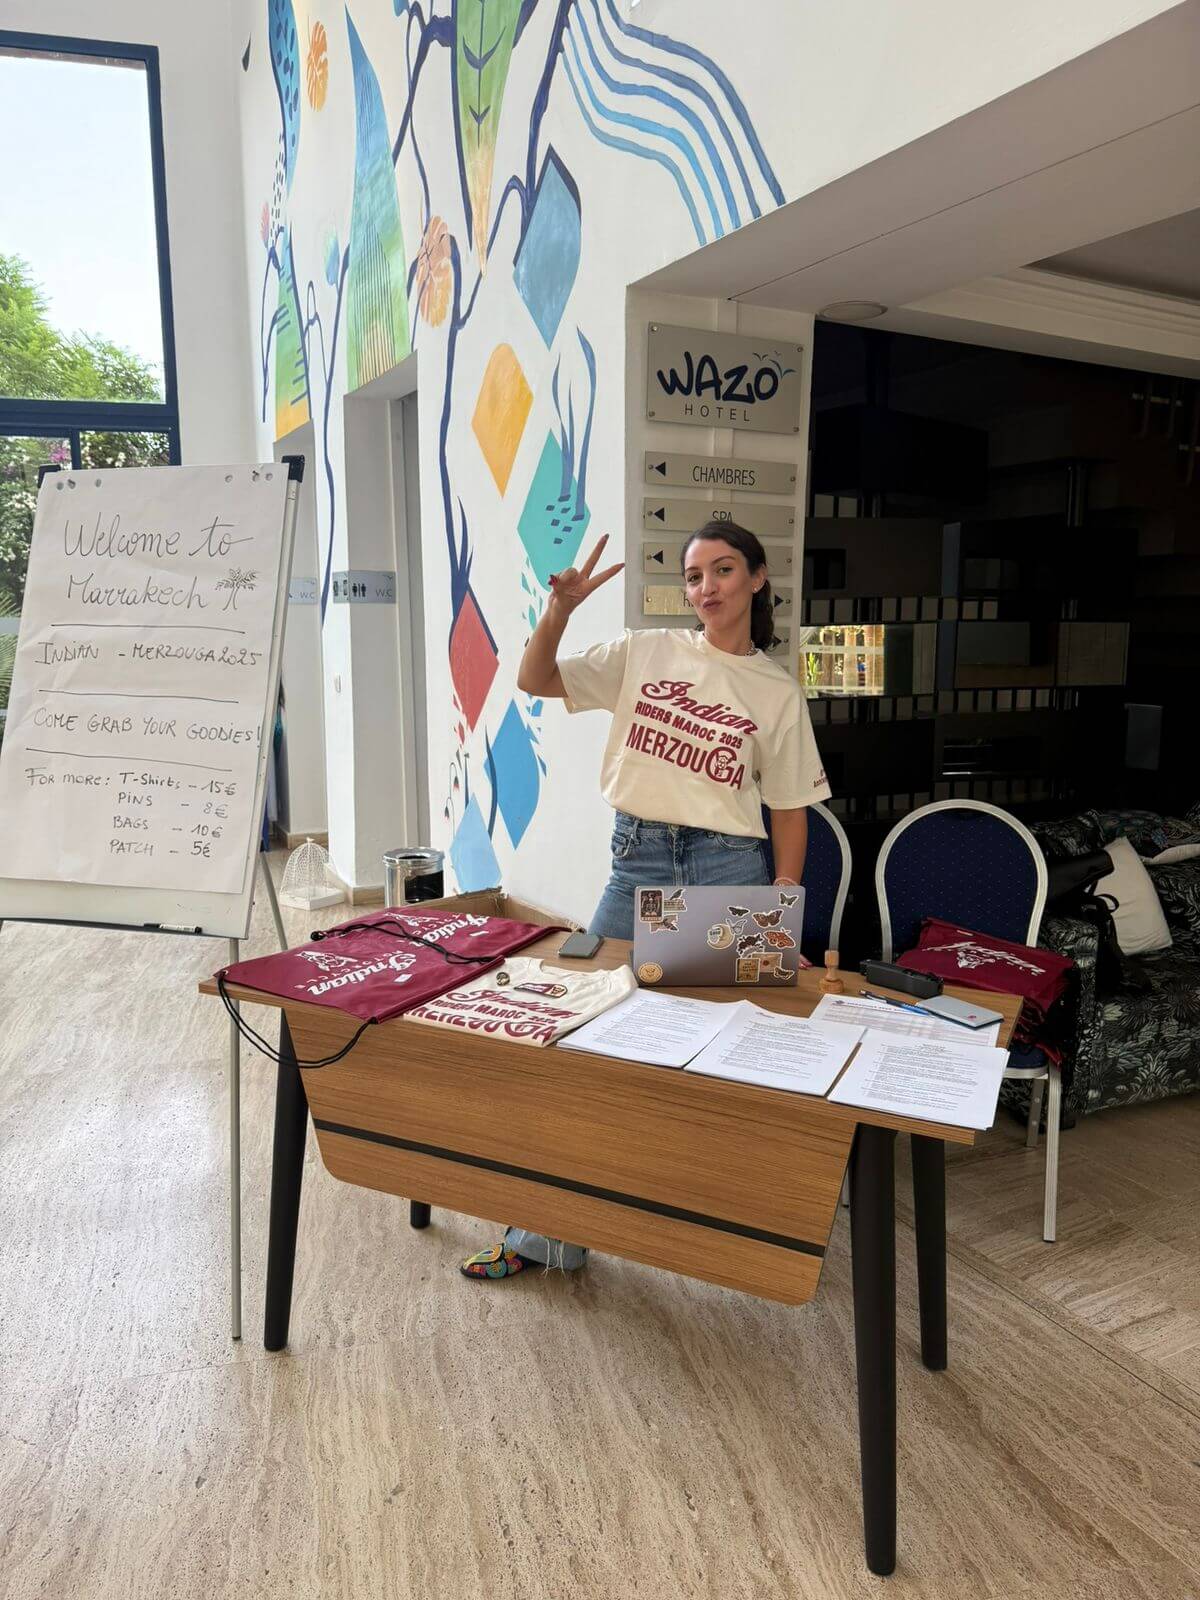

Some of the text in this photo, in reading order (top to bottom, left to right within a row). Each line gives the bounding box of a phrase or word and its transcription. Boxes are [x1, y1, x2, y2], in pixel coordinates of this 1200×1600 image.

[656, 351, 780, 404] WAZO
[684, 404, 750, 422] HOTEL
[692, 465, 756, 486] CHAMBRES
[64, 512, 254, 558] Welcome to
[67, 572, 208, 610] Marrakech
[33, 707, 78, 731] COME
[87, 715, 133, 734] GRAB
[143, 717, 177, 737] YOUR
[635, 700, 744, 750] RIDERS MAROC 2025
[641, 680, 759, 736] Indian
[626, 723, 746, 790] MERZOUGA
[113, 815, 149, 830] BAGS
[109, 838, 154, 857] PATCH
[190, 840, 212, 858] 5€
[307, 953, 417, 996] Indian
[475, 1004, 526, 1020] MAROC
